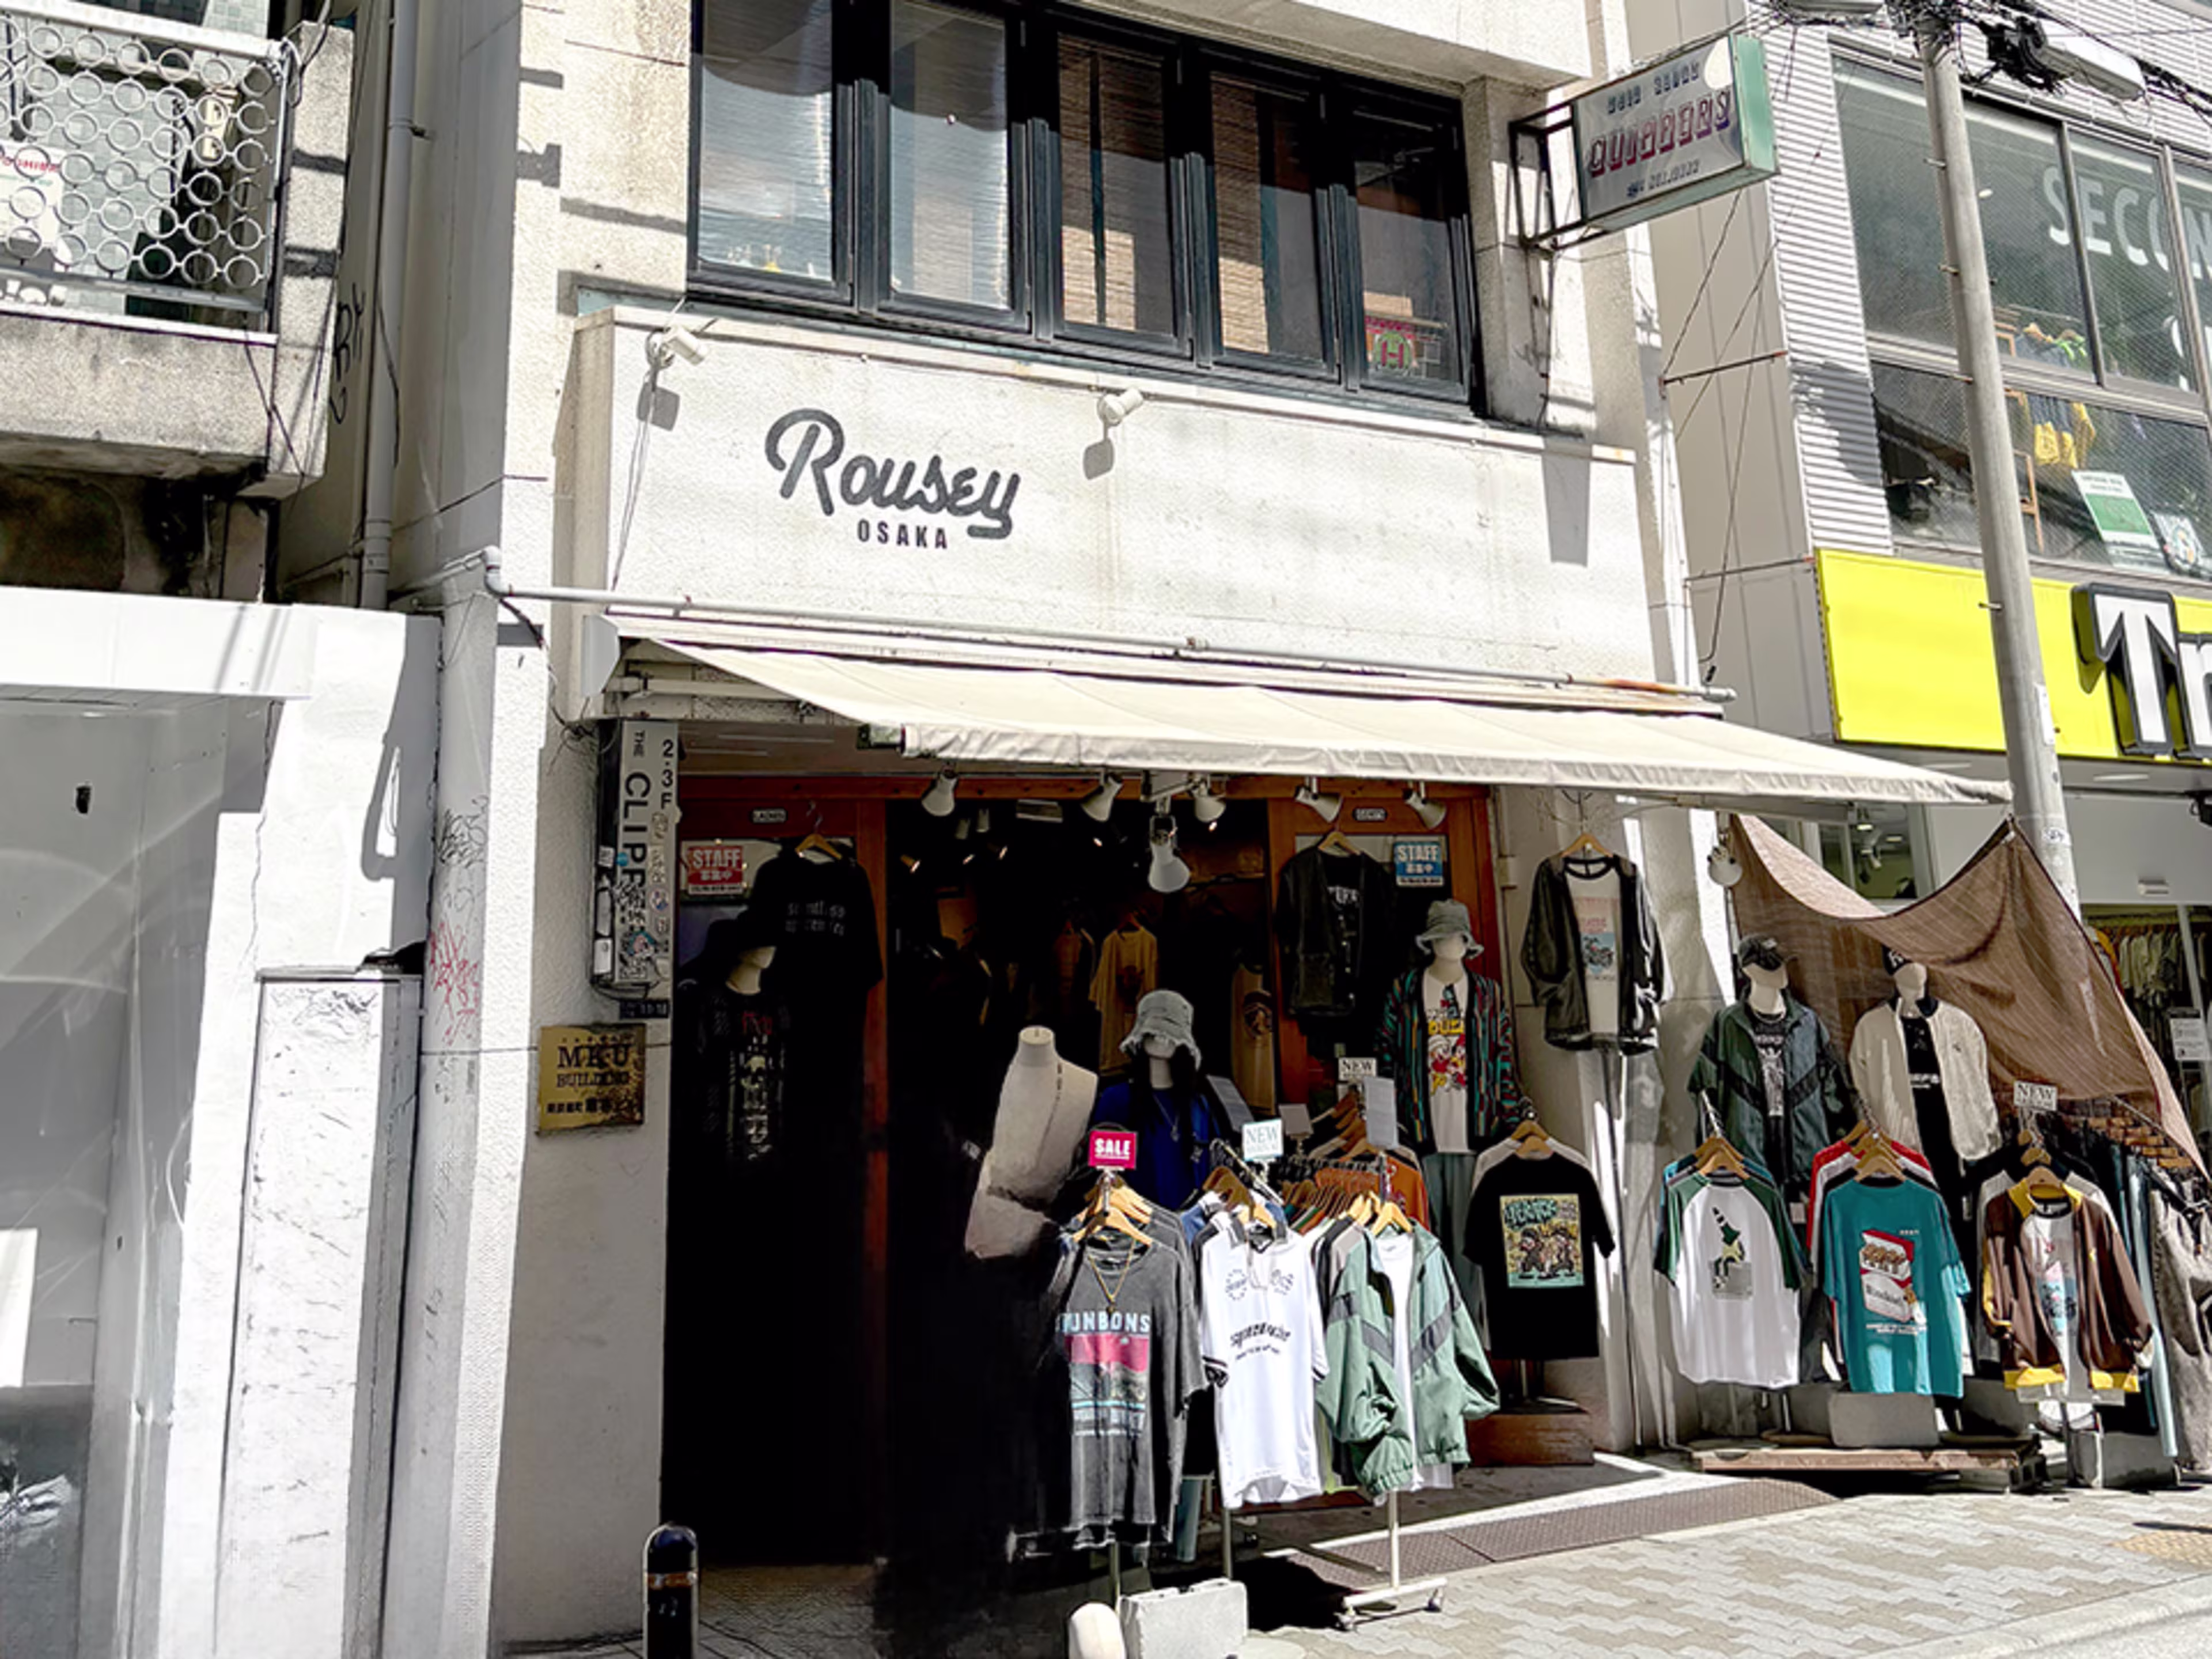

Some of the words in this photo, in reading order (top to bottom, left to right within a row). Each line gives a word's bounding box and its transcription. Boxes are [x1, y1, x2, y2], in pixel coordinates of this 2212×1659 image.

[764, 408, 1021, 540] Rousey
[857, 518, 948, 549] OSAKA
[634, 730, 646, 757] THE
[692, 848, 741, 869] STAFF
[1396, 844, 1439, 862] STAFF
[1341, 1060, 1372, 1071] NEW
[2018, 1084, 2054, 1100] NEW
[1246, 1125, 1279, 1145] NEW
[1094, 1138, 1131, 1156] SALE
